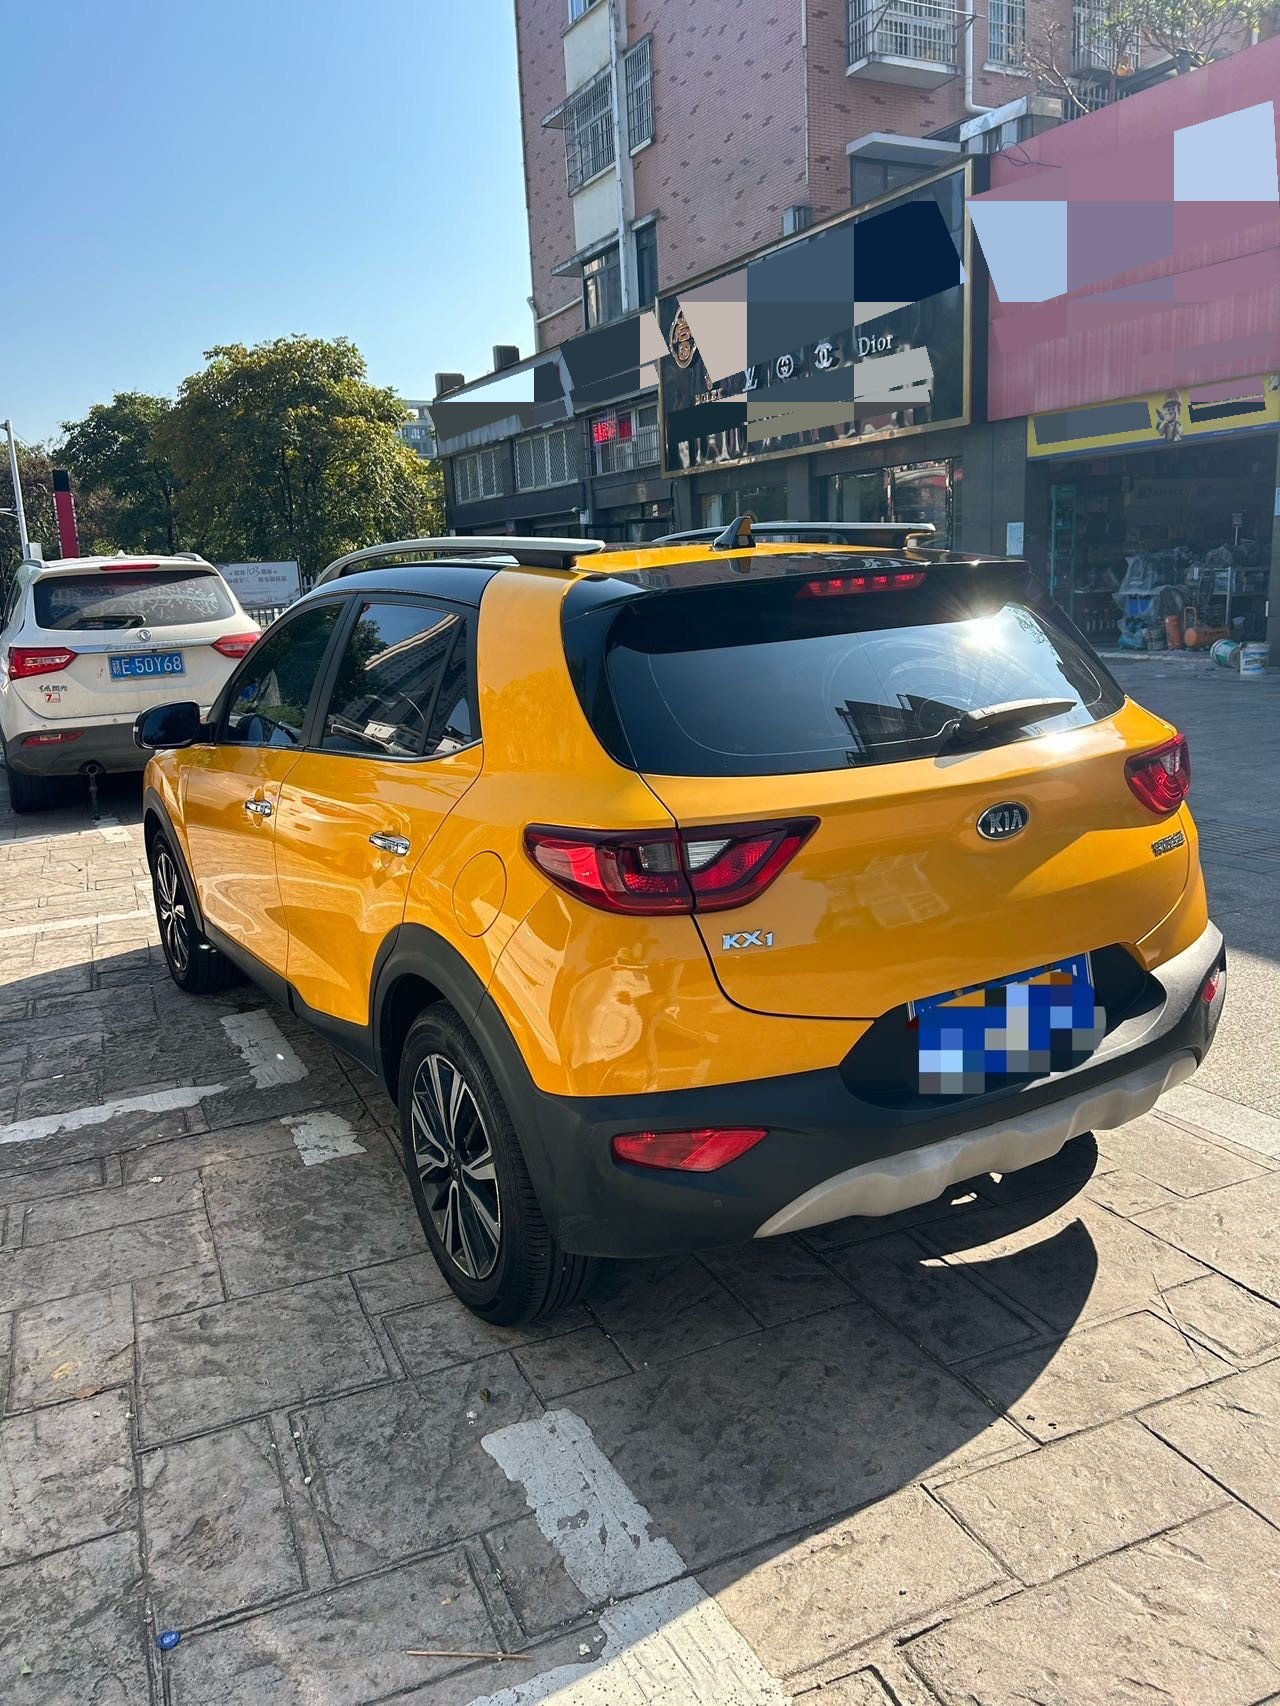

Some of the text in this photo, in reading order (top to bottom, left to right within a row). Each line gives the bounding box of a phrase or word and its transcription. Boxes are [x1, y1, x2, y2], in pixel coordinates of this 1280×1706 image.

[858, 334, 894, 357] Dior
[989, 809, 1023, 834] KIA
[722, 930, 774, 951] KX1
